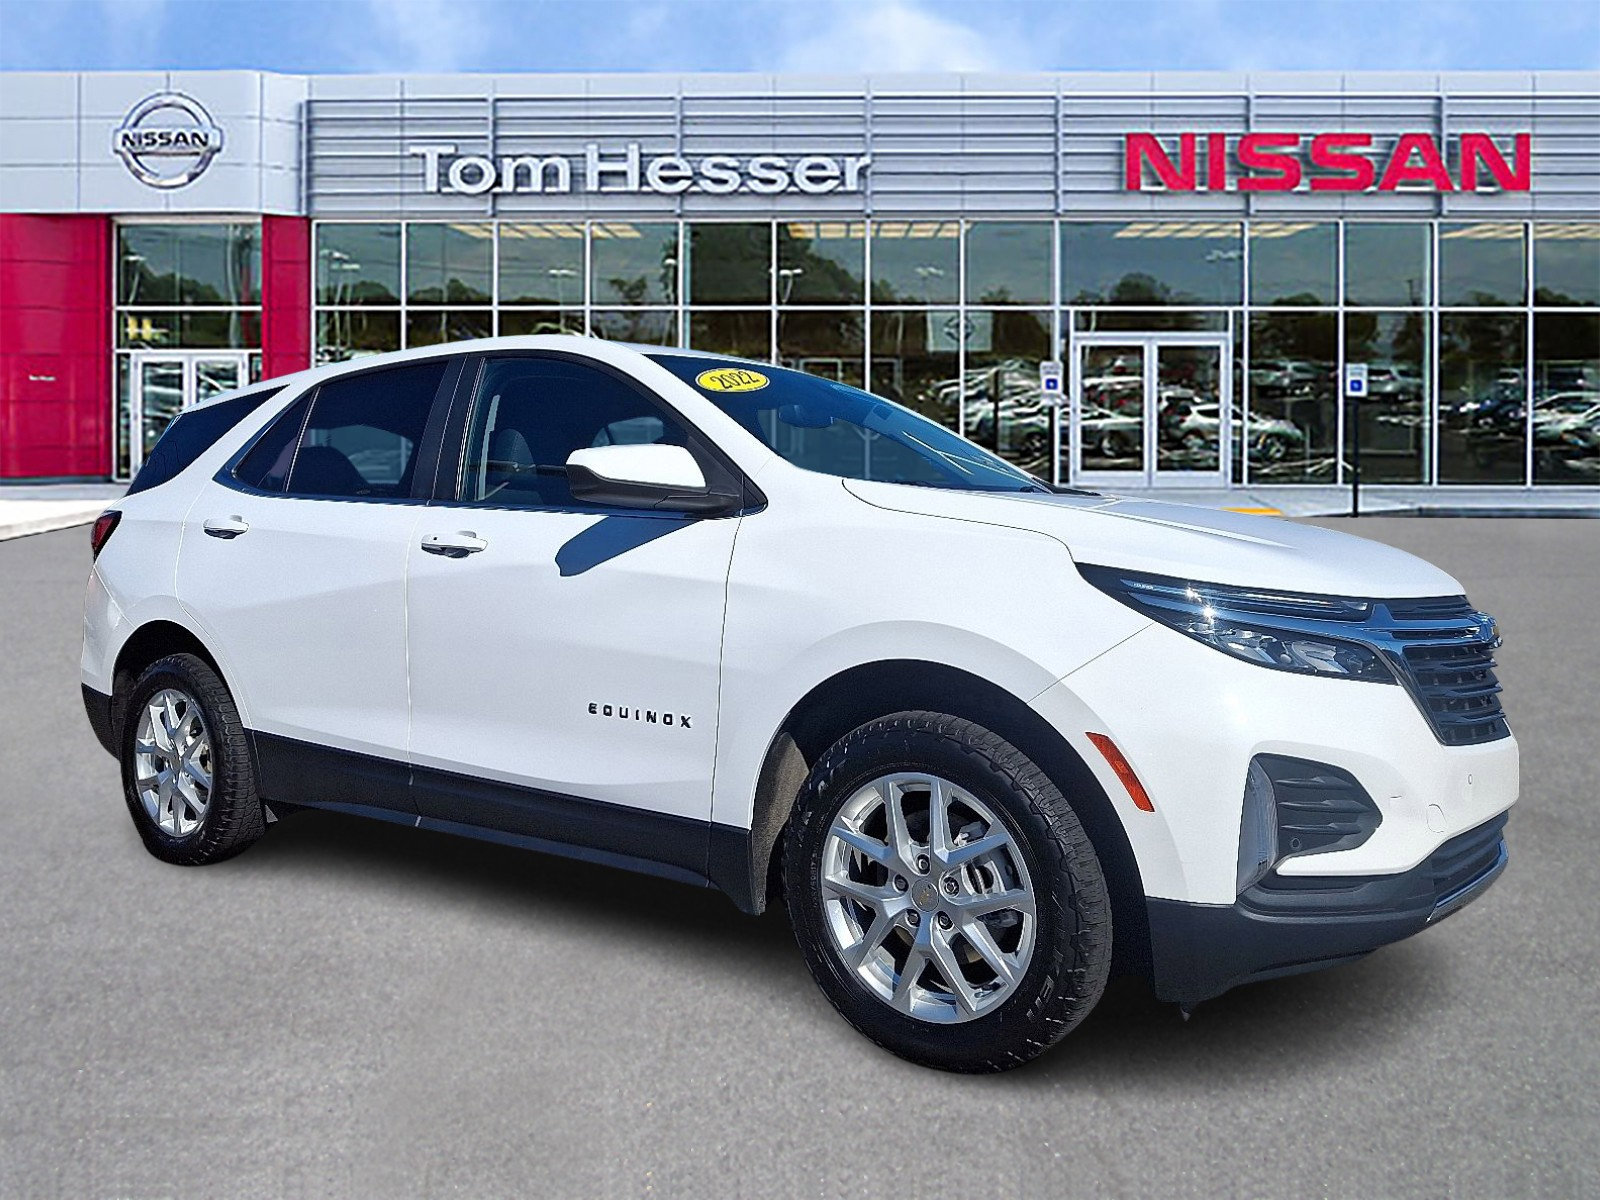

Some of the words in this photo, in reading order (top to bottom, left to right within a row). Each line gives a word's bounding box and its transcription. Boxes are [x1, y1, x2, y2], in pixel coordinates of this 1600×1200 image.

[122, 132, 209, 147] NISSAN
[409, 144, 571, 193] Tom
[584, 143, 871, 193] Hesser
[1126, 132, 1531, 192] NISSAN
[709, 371, 760, 389] 2022
[588, 702, 691, 729] EQUINOX
